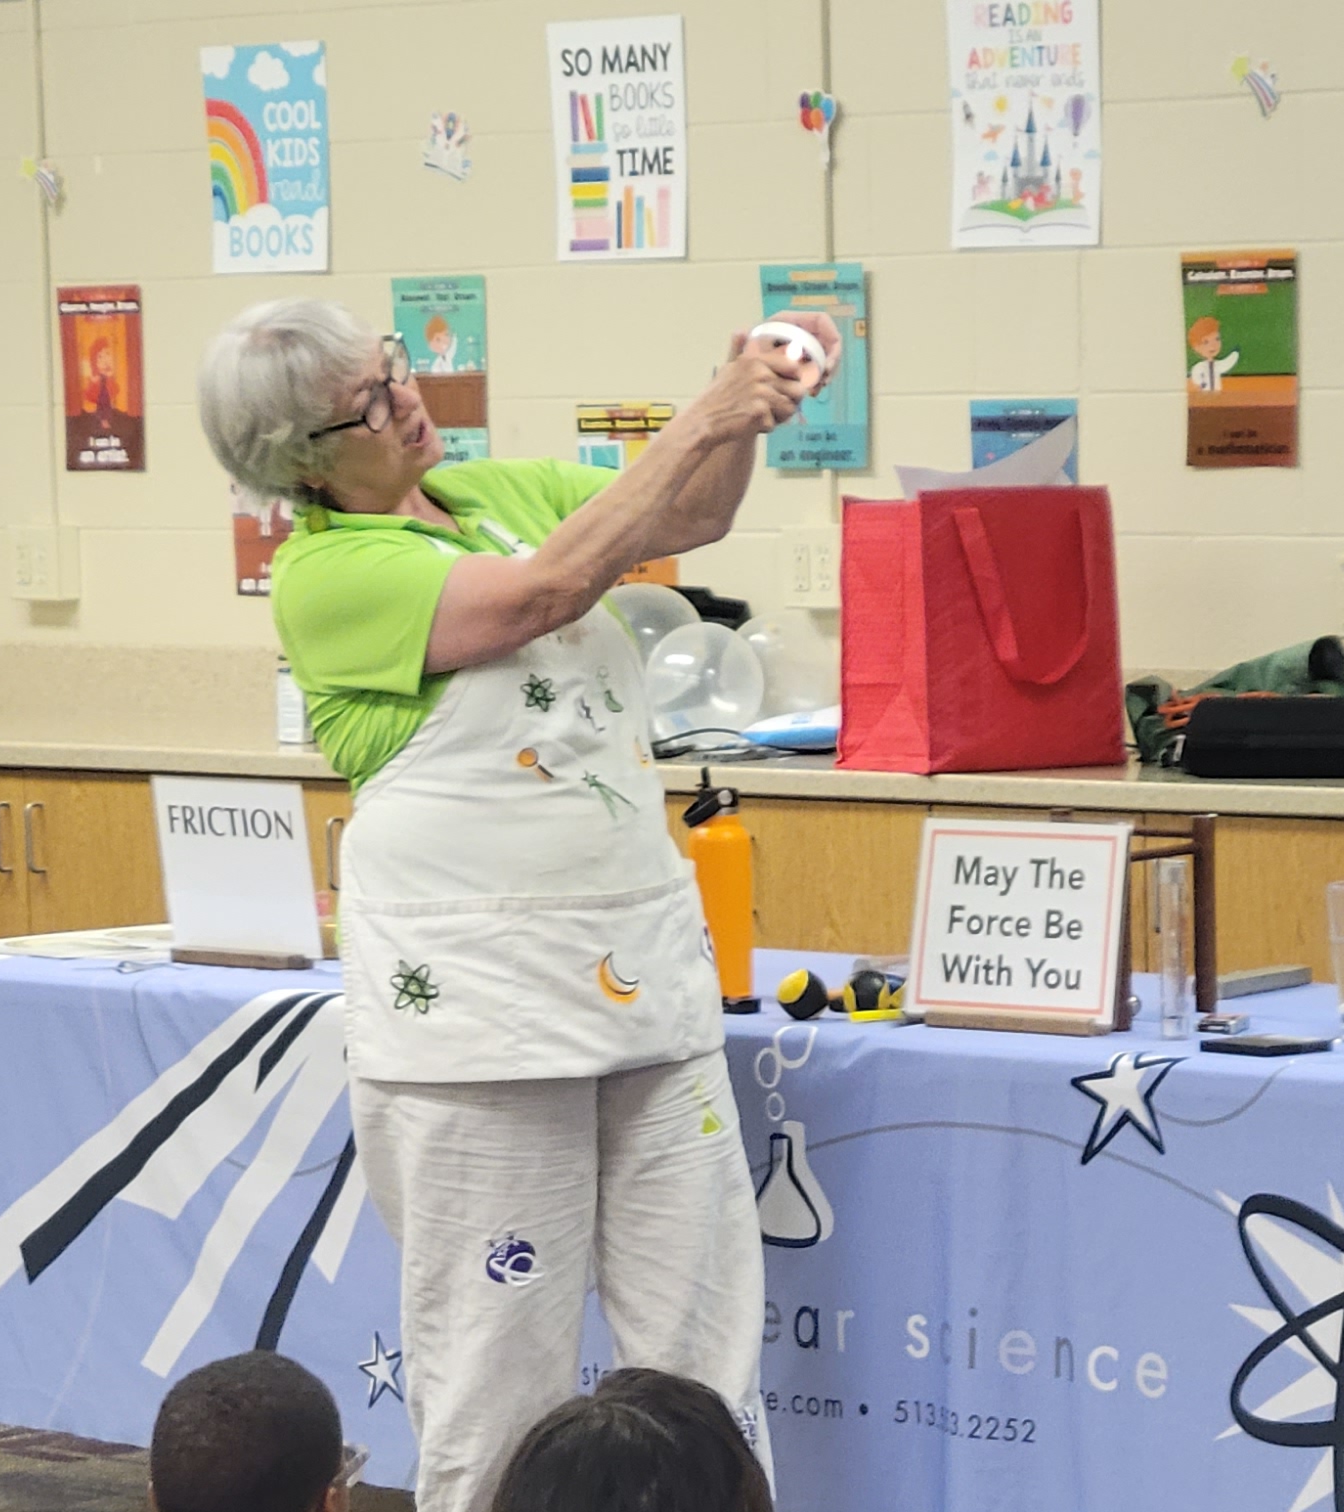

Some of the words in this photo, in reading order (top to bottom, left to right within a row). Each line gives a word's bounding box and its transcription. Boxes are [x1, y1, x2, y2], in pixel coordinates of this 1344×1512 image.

[973, 1, 1073, 28] READING
[1008, 29, 1024, 43] IS
[1026, 29, 1042, 42] AN
[561, 47, 592, 77] SO
[601, 42, 672, 74] MANY
[967, 43, 1082, 70] ADVENTURE
[609, 81, 675, 112] BOOKS
[263, 100, 322, 132] COOL
[612, 121, 632, 142] so
[635, 114, 676, 139] little
[266, 137, 321, 167] KIDS
[616, 146, 675, 177] TIME
[269, 168, 326, 201] read
[229, 223, 314, 258] BOOKS
[167, 804, 295, 840] FRICTION
[954, 855, 1019, 897] May
[1029, 858, 1086, 890] The
[946, 905, 1031, 938] Force
[1044, 909, 1083, 941] Be
[941, 953, 1013, 987] With
[1024, 957, 1082, 991] You
[904, 1306, 1170, 1399] science
[760, 1390, 845, 1419] e.com
